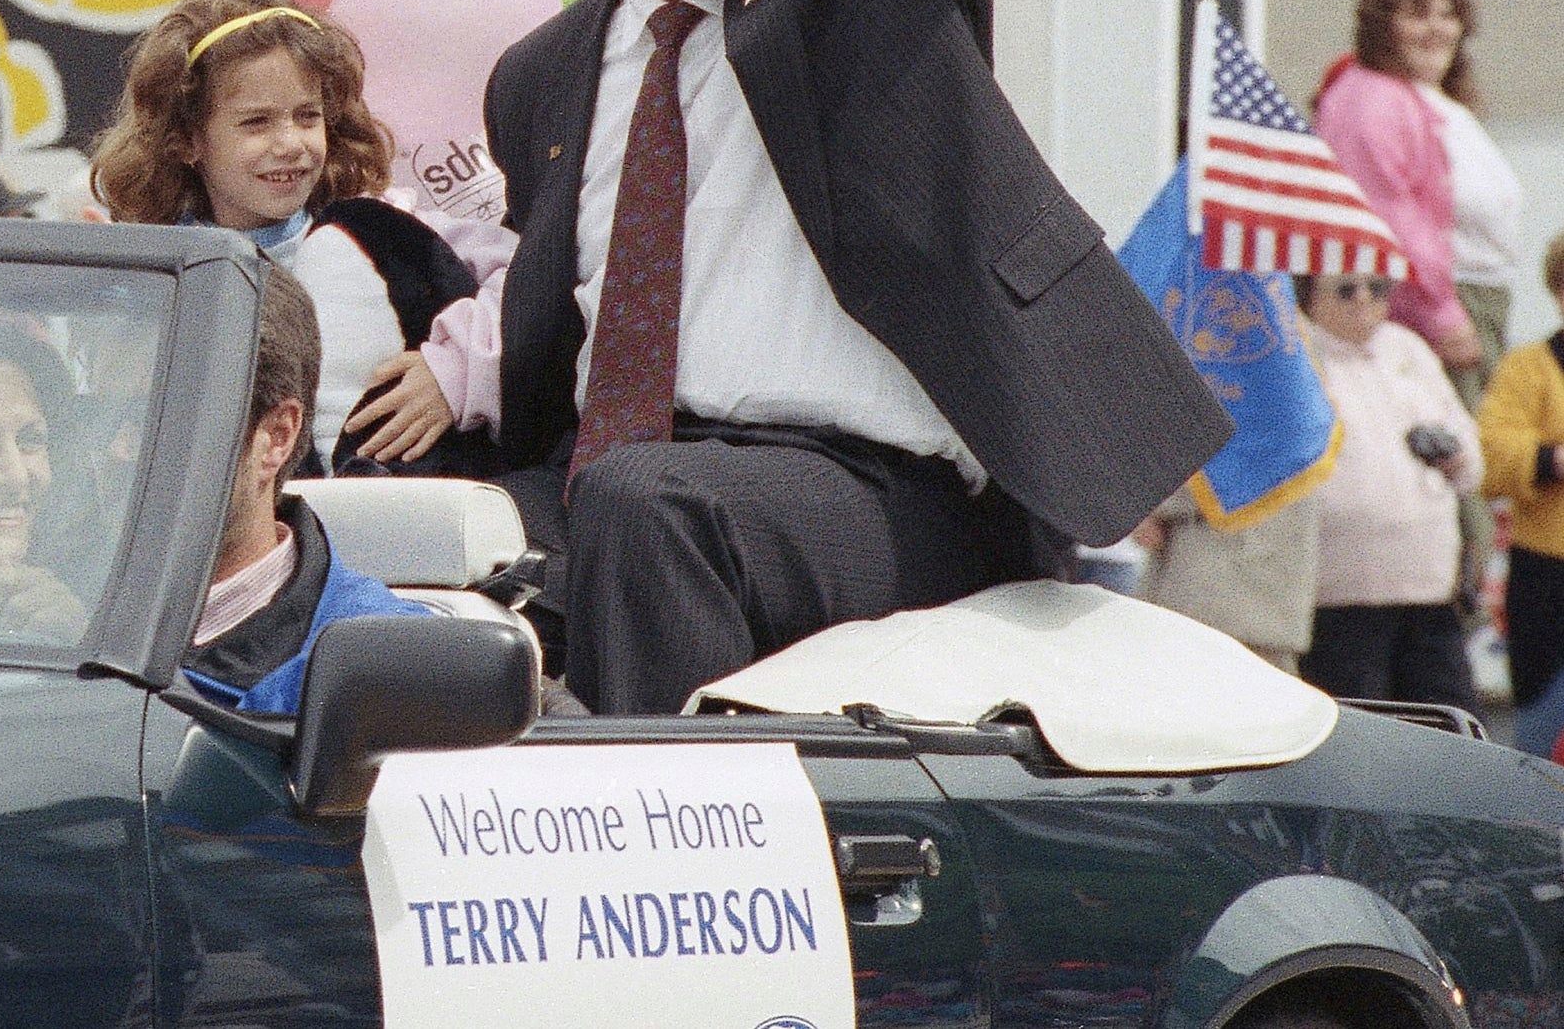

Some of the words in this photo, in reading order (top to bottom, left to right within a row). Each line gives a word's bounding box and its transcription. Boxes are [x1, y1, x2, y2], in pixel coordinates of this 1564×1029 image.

[418, 788, 628, 857] Welcome
[637, 788, 767, 852] Home
[408, 897, 550, 967] TERRY
[576, 887, 818, 961] ANDERSON
